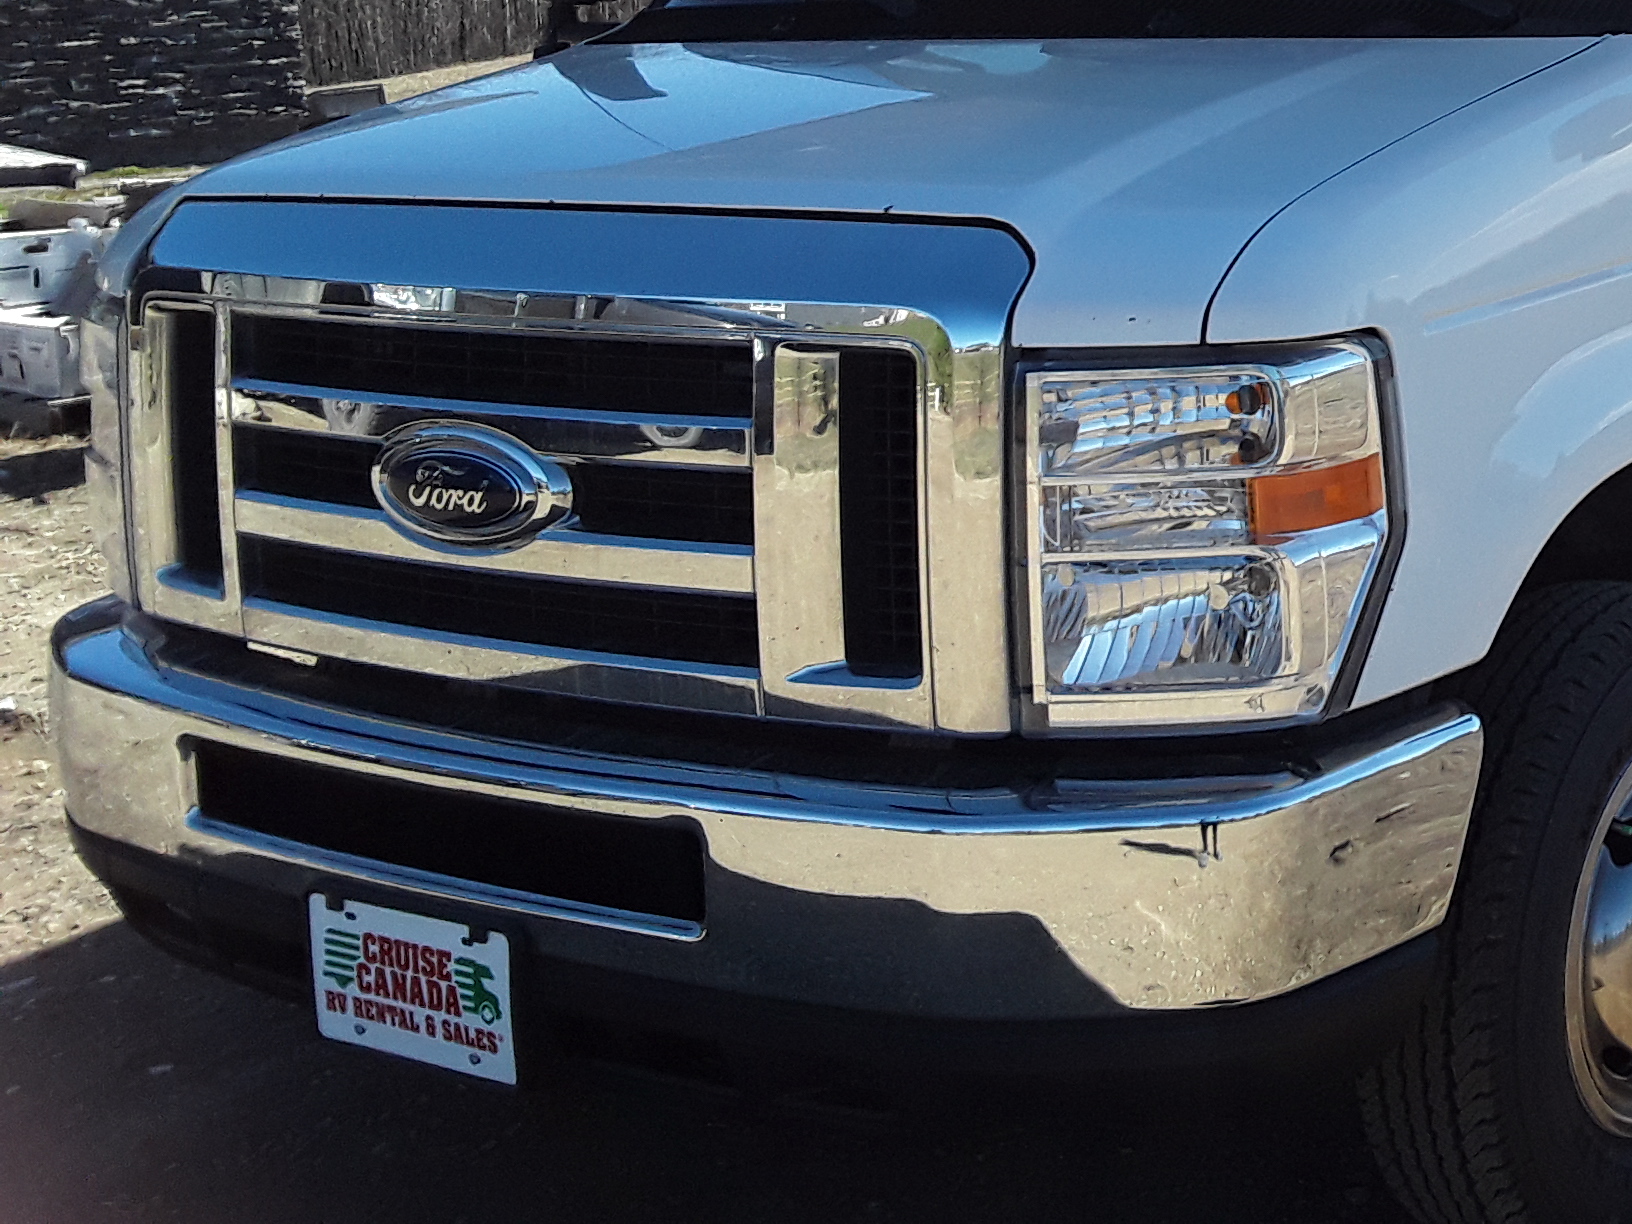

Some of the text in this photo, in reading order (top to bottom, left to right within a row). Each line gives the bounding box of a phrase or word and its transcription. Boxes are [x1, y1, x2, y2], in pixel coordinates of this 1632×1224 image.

[408, 460, 489, 514] Ford
[362, 932, 453, 982] CRUISE
[355, 962, 463, 1018] CANADA
[325, 989, 499, 1055] RV RENTAL & SALES
